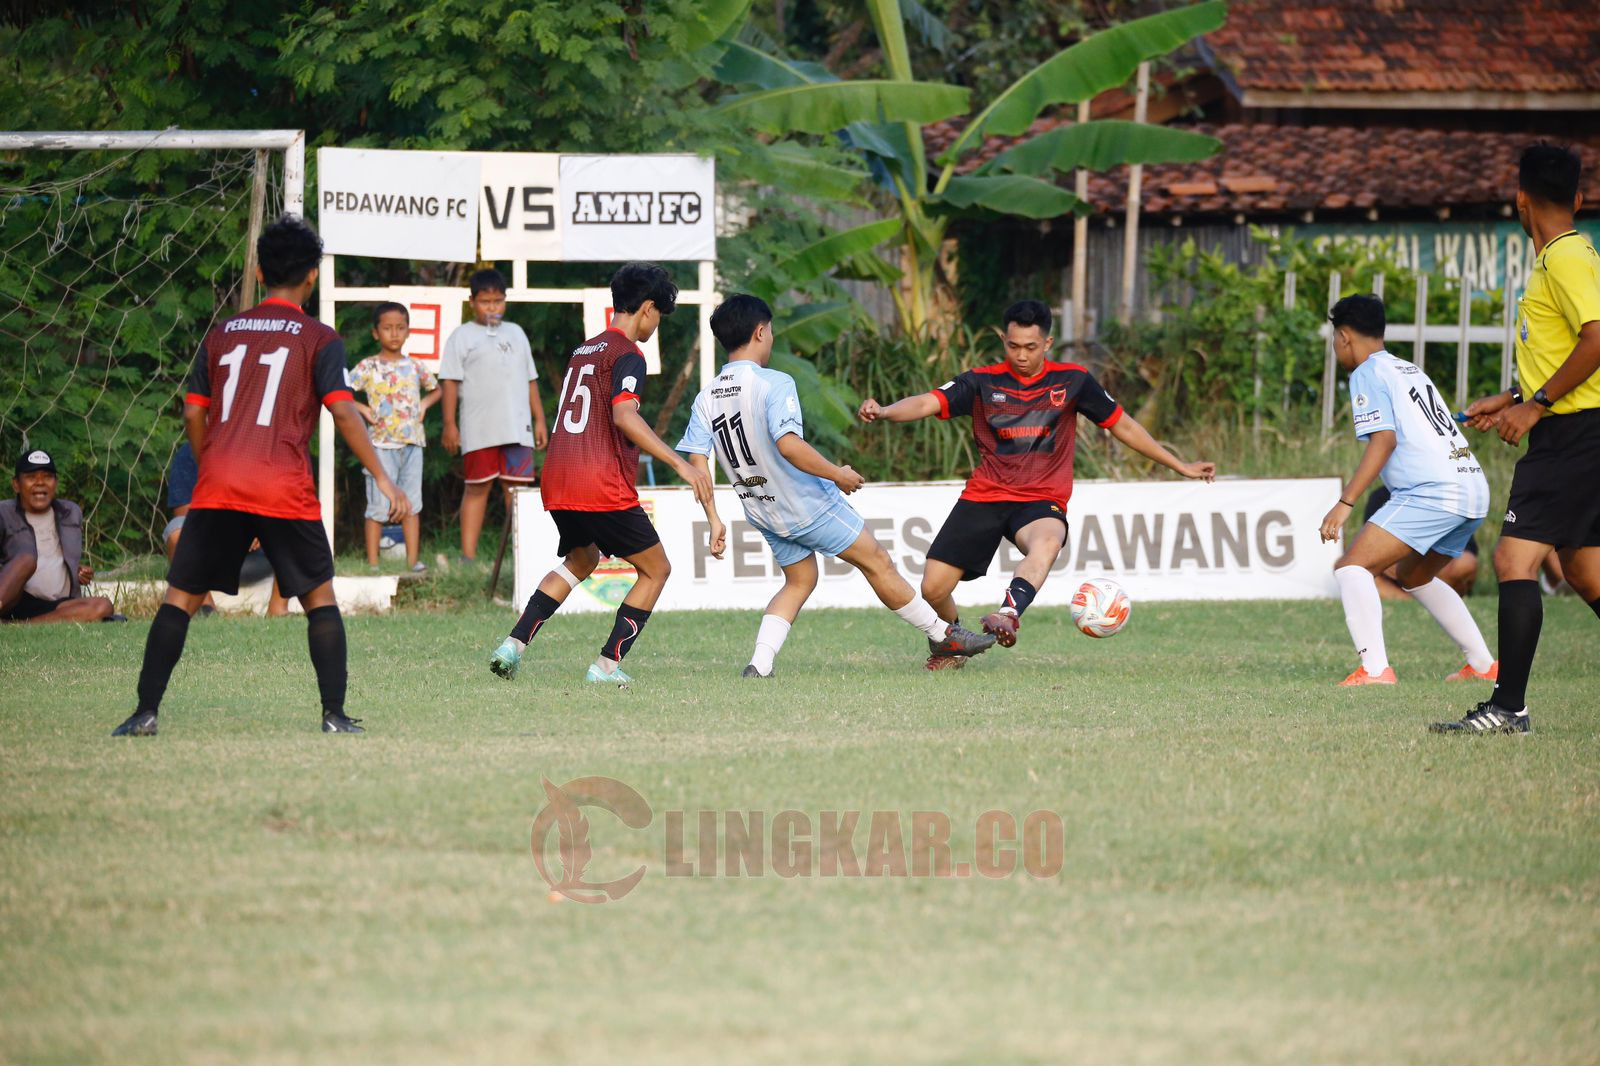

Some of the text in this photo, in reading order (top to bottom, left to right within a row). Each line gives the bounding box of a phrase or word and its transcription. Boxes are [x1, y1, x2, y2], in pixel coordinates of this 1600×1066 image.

[323, 190, 467, 218] PEDAWANG FC
[484, 186, 555, 231] VS
[572, 191, 701, 224] AMN FC
[1434, 232, 1498, 291] IKAN
[224, 318, 303, 335] PEDAWANG FC
[218, 344, 290, 427] 11
[552, 364, 595, 434] 15
[711, 411, 757, 469] 11
[692, 510, 1295, 580] PEES AWANG
